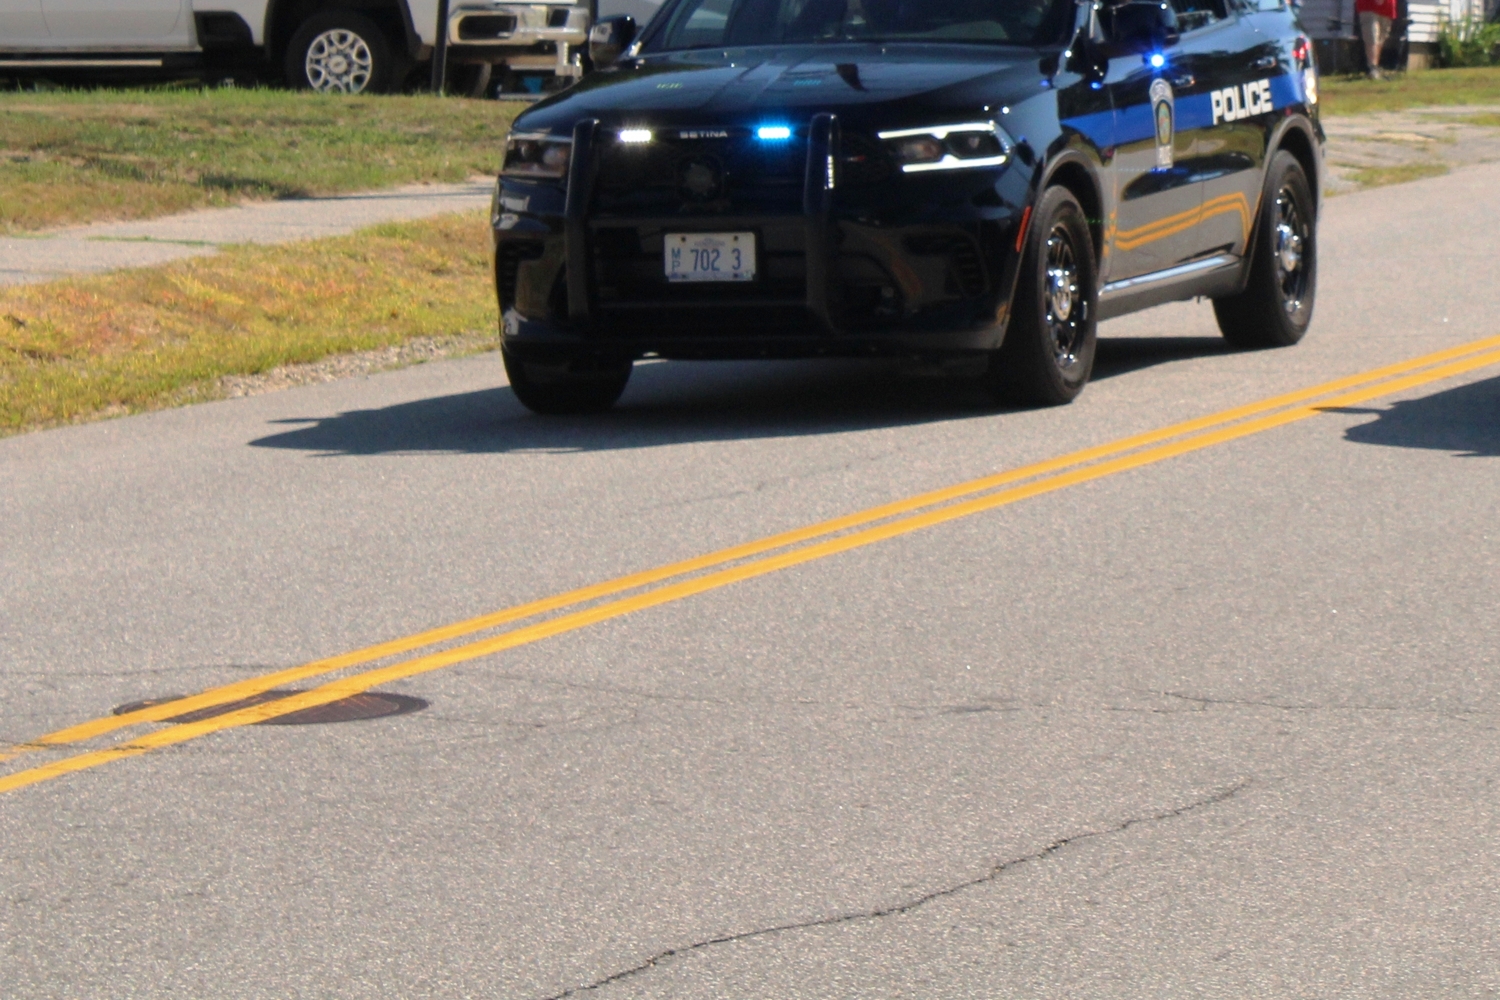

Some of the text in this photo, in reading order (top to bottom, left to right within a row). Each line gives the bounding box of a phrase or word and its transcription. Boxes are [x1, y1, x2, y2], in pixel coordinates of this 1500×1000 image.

[1210, 78, 1274, 126] POLICE
[680, 131, 728, 139] SETINA
[690, 247, 742, 272] 702 3
